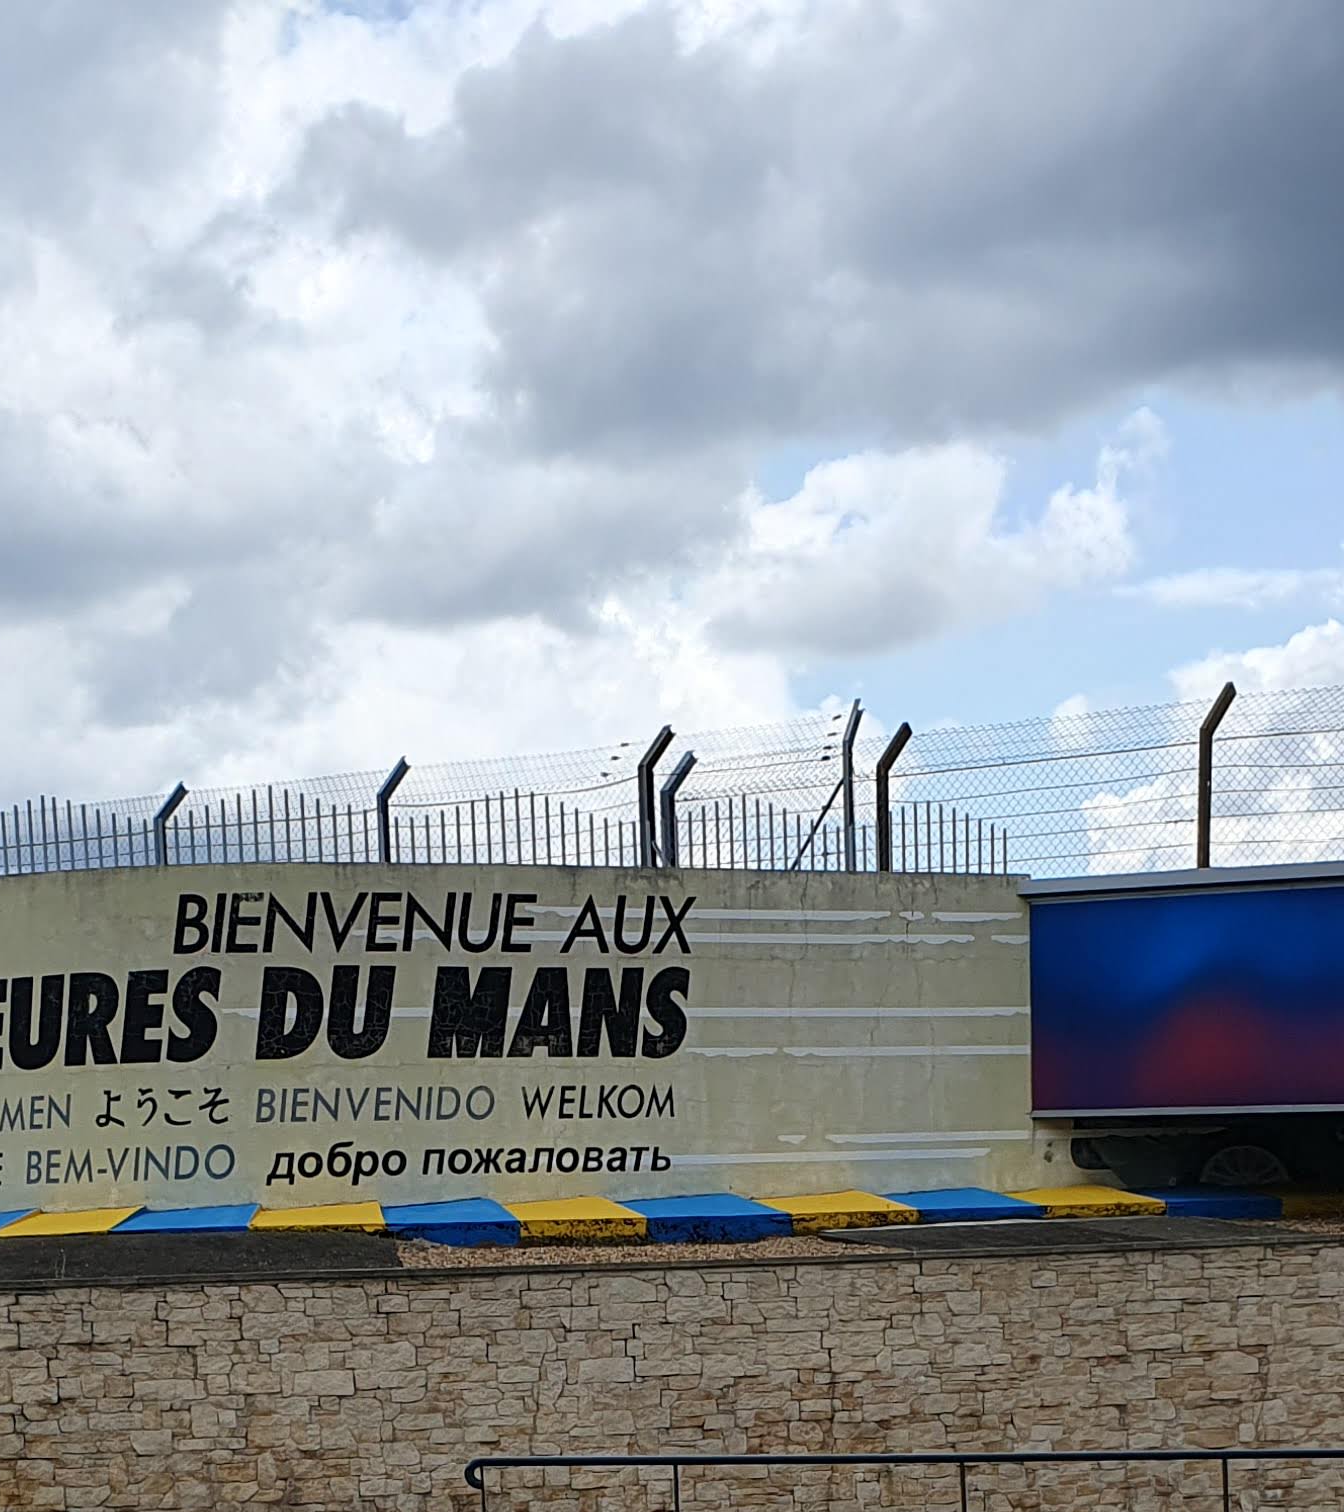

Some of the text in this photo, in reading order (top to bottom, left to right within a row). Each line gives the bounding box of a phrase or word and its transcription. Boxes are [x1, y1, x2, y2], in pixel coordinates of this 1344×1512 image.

[173, 891, 697, 954] BIENVENUE AUX
[256, 964, 397, 1061] DU
[427, 965, 690, 1059] MANS
[95, 1087, 229, 1127] ようこそ
[256, 1084, 675, 1123] BIENVENIDO WELKOM
[26, 1143, 236, 1184] BEM-VINDO
[267, 1141, 671, 1185] добро пожаловать
